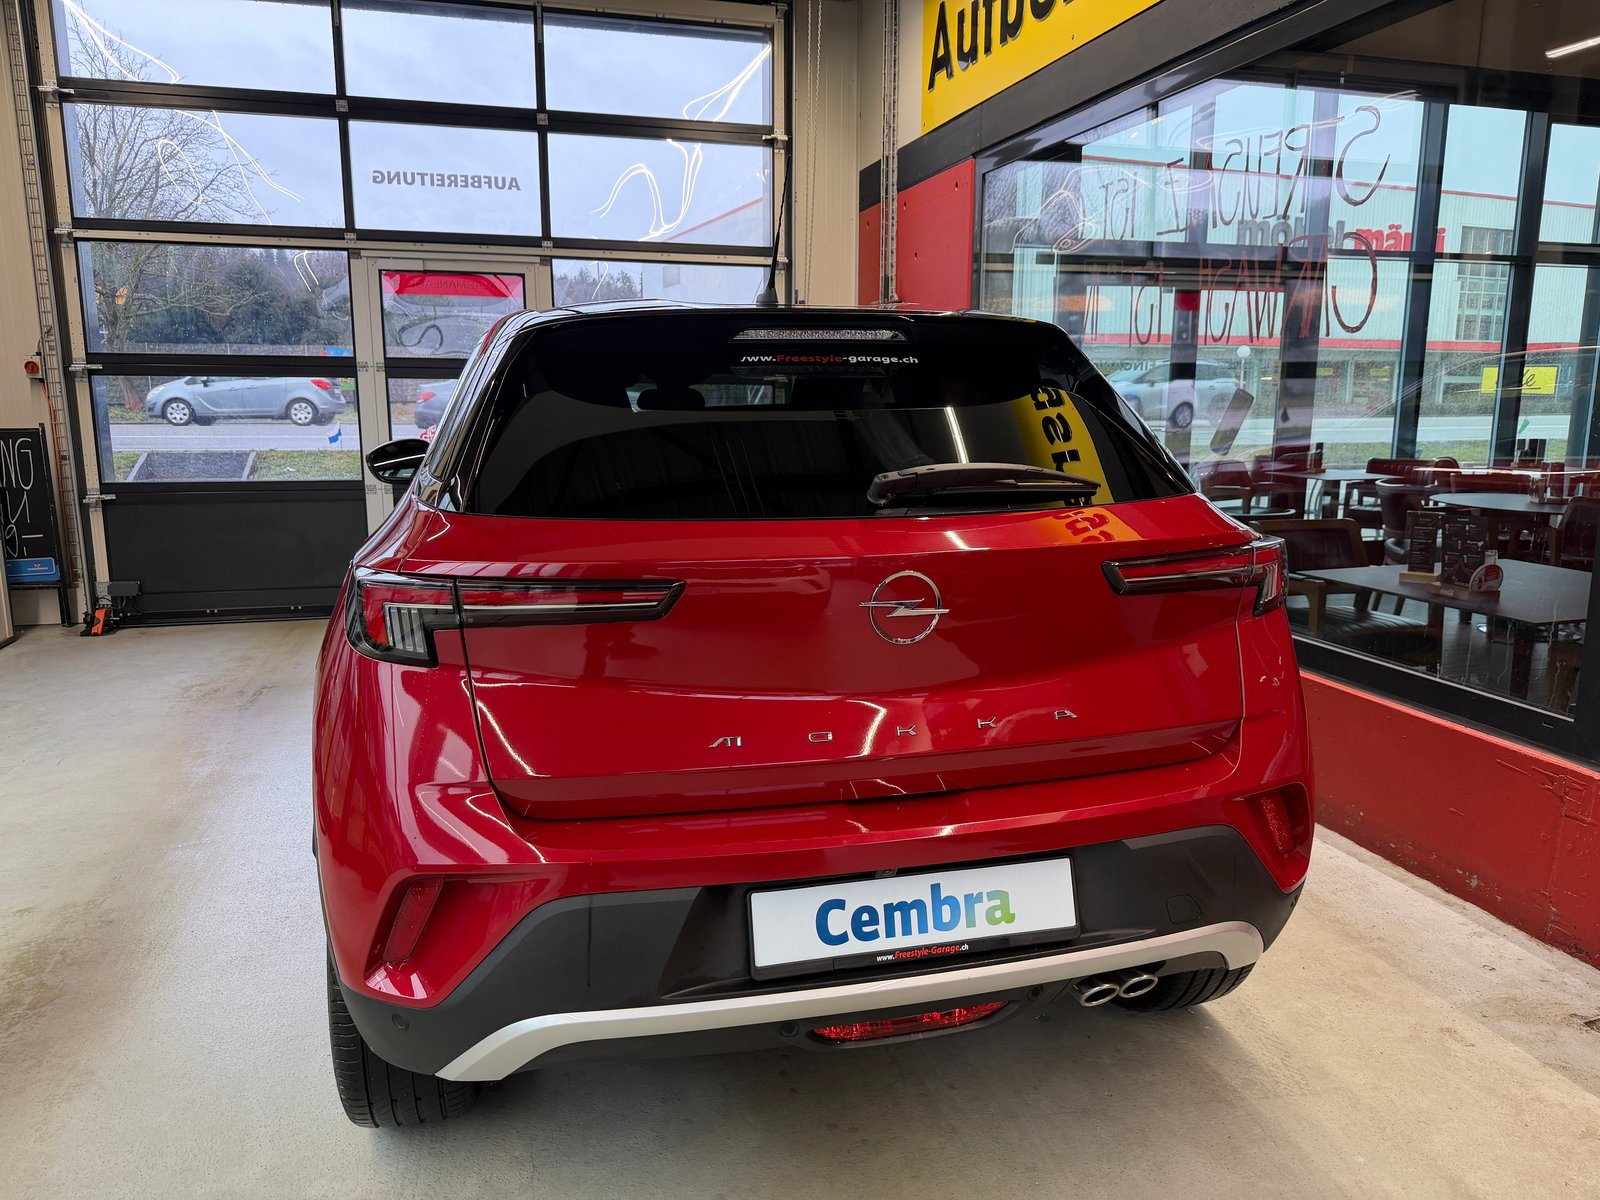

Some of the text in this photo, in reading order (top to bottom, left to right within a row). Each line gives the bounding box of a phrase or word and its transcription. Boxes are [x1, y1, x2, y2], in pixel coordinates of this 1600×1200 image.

[928, 0, 1075, 93] Aufb
[815, 882, 1016, 946] Cembra
[876, 943, 969, 961] www.Freestyle-Garage.ch
